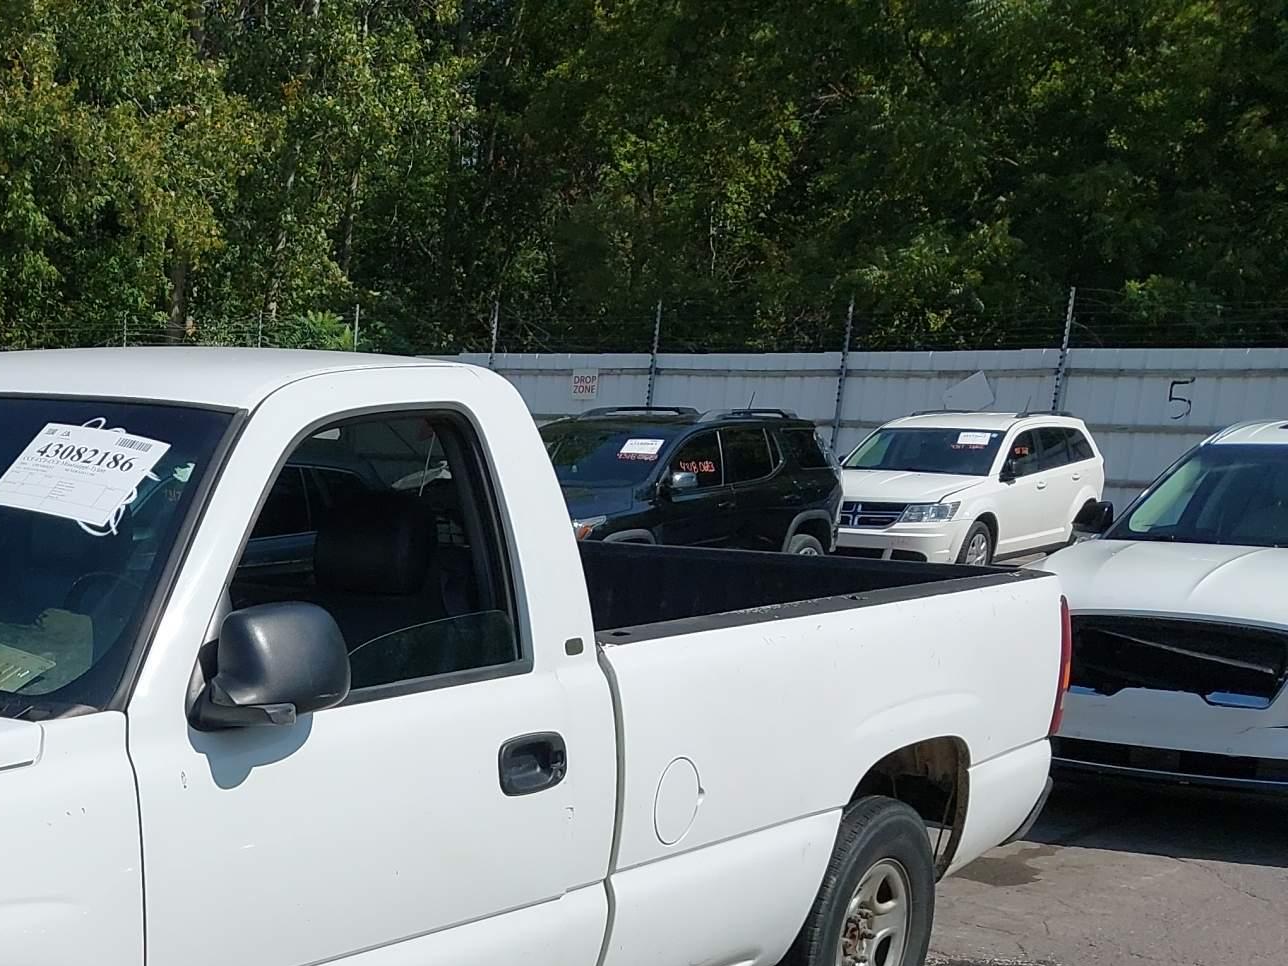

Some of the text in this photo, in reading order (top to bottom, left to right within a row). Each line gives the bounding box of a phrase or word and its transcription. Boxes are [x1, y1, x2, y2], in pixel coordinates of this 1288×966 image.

[573, 375, 597, 385] DROP
[573, 384, 596, 394] ZONE
[1169, 377, 1196, 420] 5
[36, 442, 139, 473] 43082186
